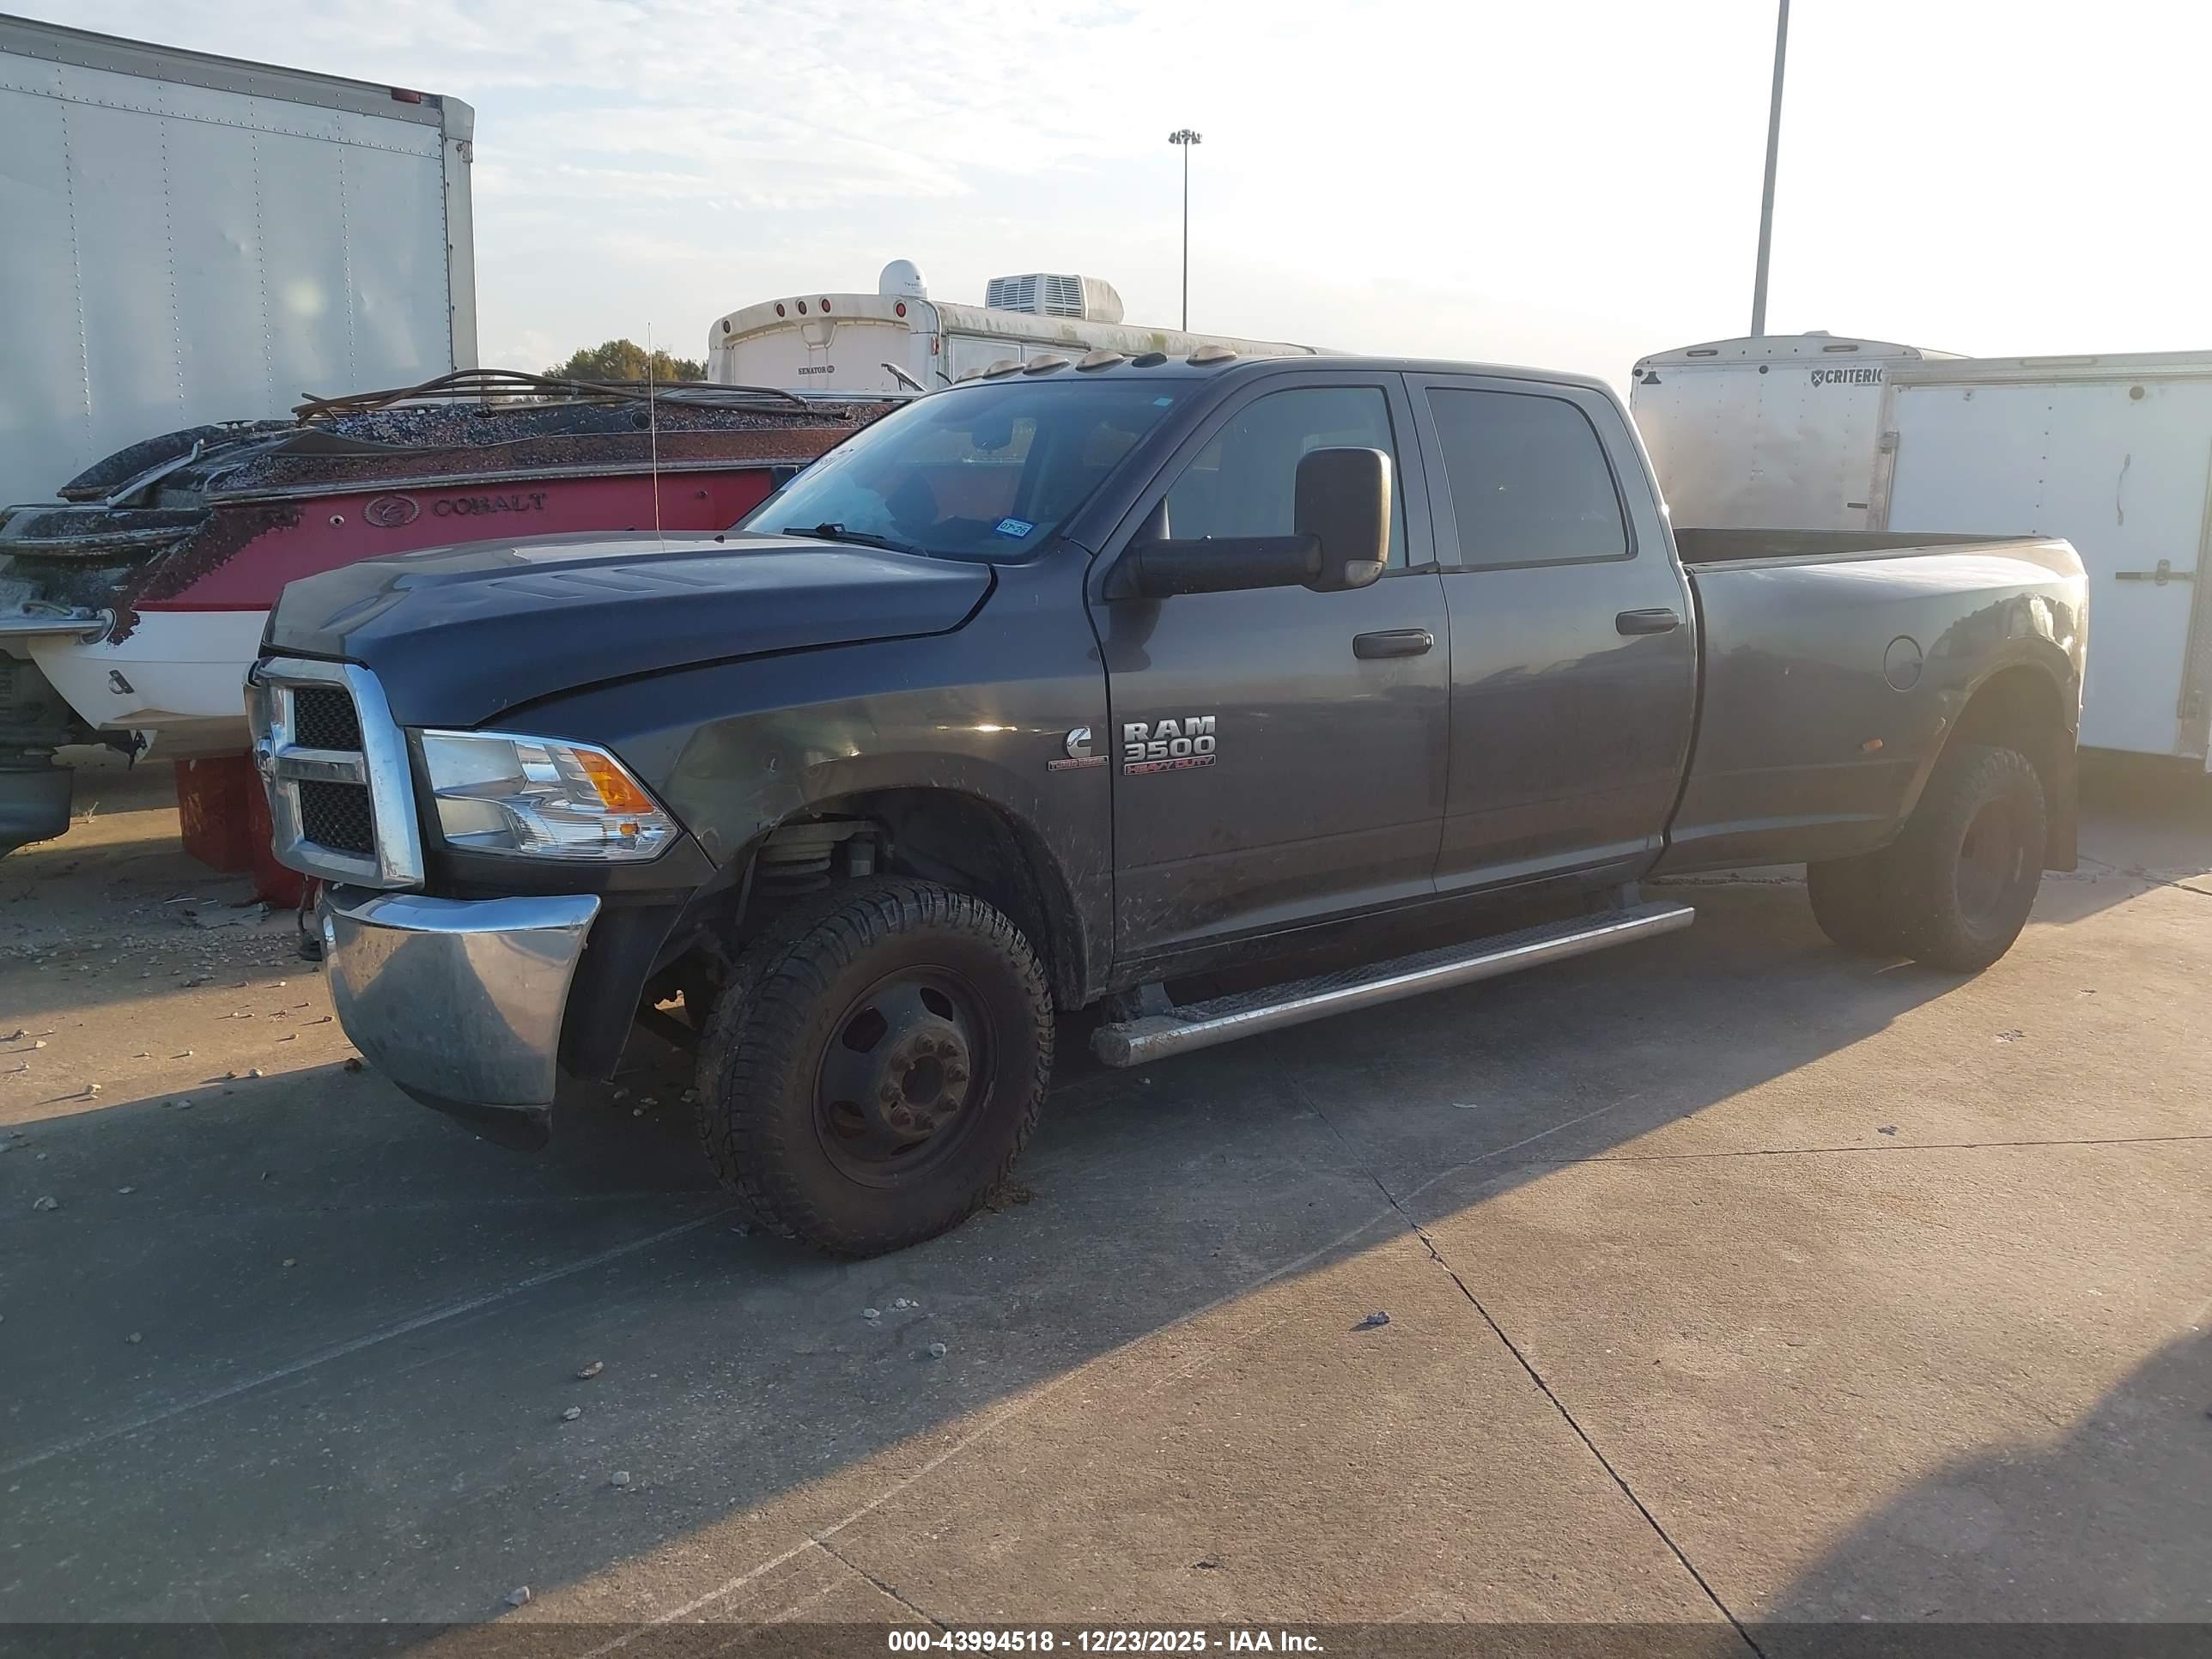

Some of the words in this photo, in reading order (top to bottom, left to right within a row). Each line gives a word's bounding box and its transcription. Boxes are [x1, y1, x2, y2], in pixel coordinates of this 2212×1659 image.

[798, 366, 827, 375] SENATOR
[433, 492, 547, 517] COBALT
[1122, 715, 1217, 743] RAM
[1122, 735, 1216, 763] 3500
[1126, 761, 1174, 774] HEAVY
[1175, 756, 1214, 769] DUTY
